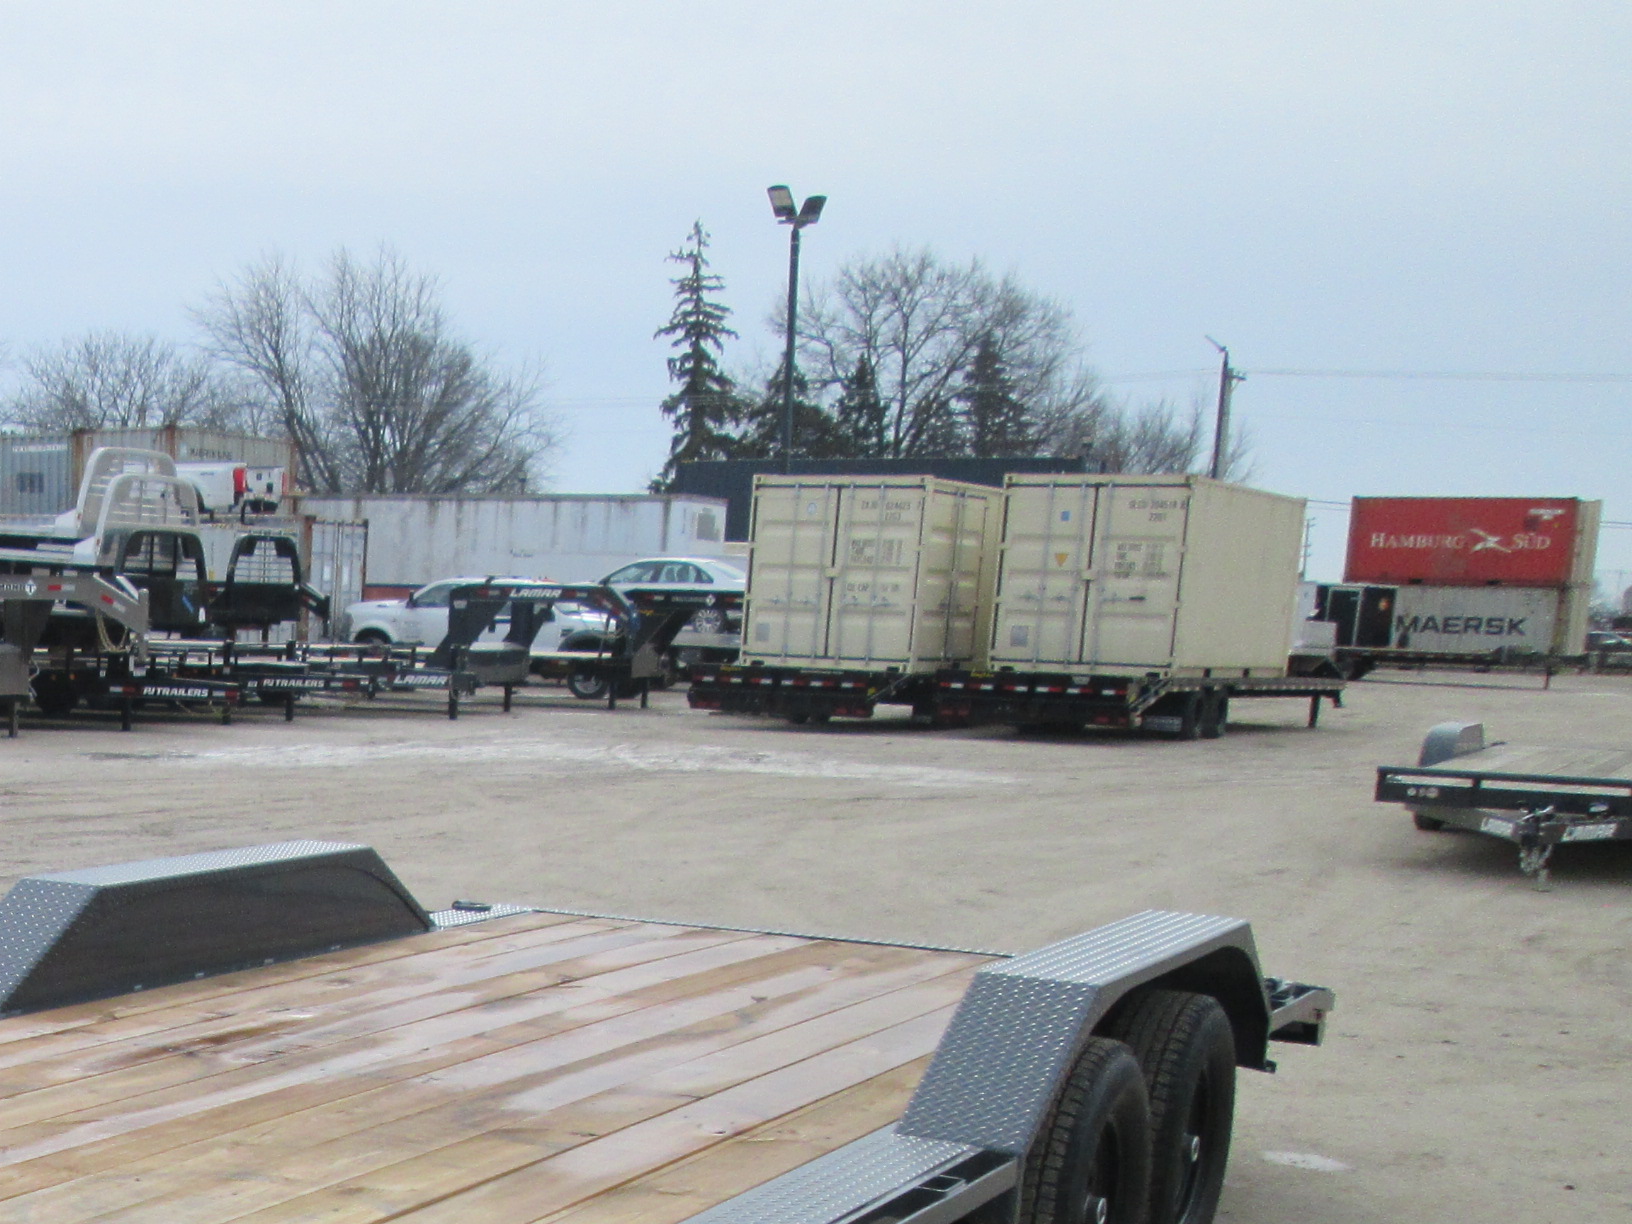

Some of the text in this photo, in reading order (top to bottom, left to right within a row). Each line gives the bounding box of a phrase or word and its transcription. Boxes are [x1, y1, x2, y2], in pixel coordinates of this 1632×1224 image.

[1371, 532, 1552, 550] HAMBURG SÜD
[509, 588, 562, 598] LAMAR
[1395, 615, 1526, 635] MAERSK
[275, 679, 325, 688] TRAILERS
[393, 674, 448, 685] LAMAR
[156, 687, 209, 697] TRAILERS
